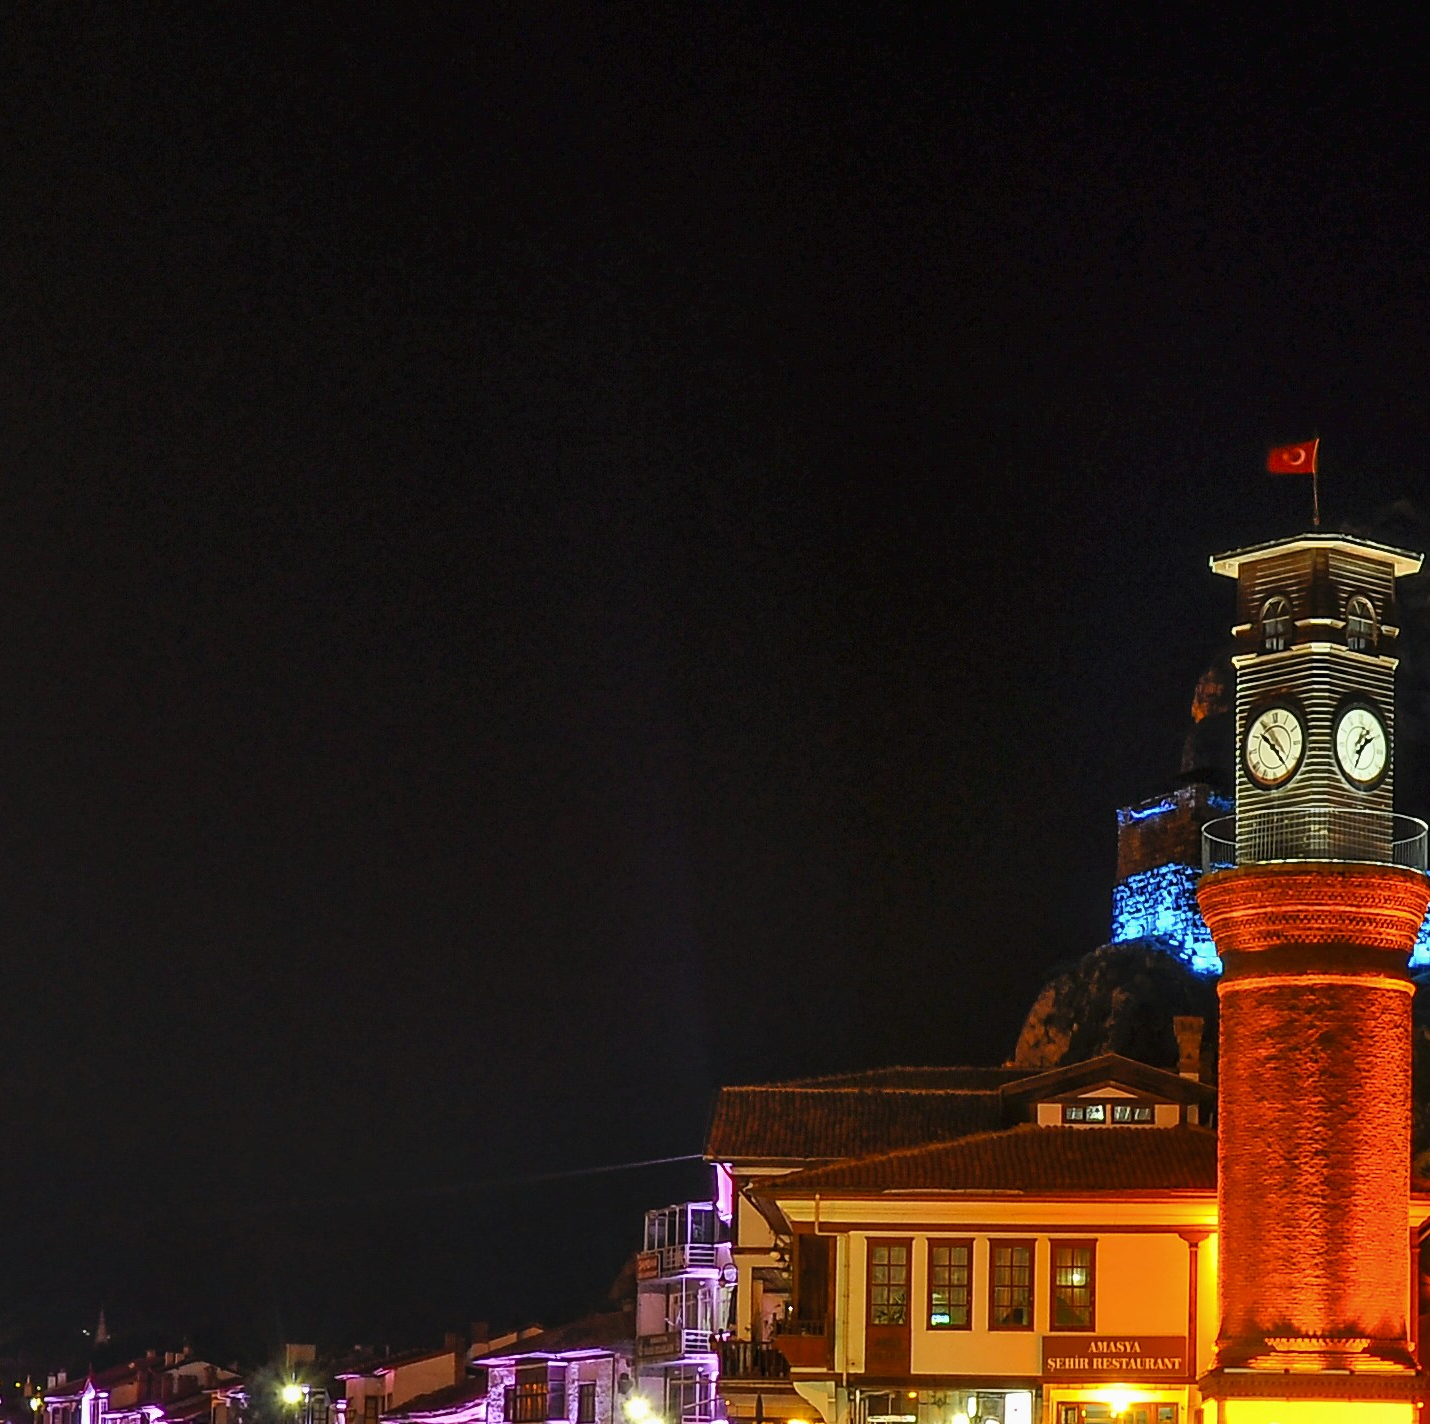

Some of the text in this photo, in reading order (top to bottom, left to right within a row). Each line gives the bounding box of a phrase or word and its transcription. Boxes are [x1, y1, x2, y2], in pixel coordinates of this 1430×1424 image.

[1088, 1341, 1141, 1353] AMASYA
[1047, 1355, 1182, 1372] ŞEHİR RESTAURANT
